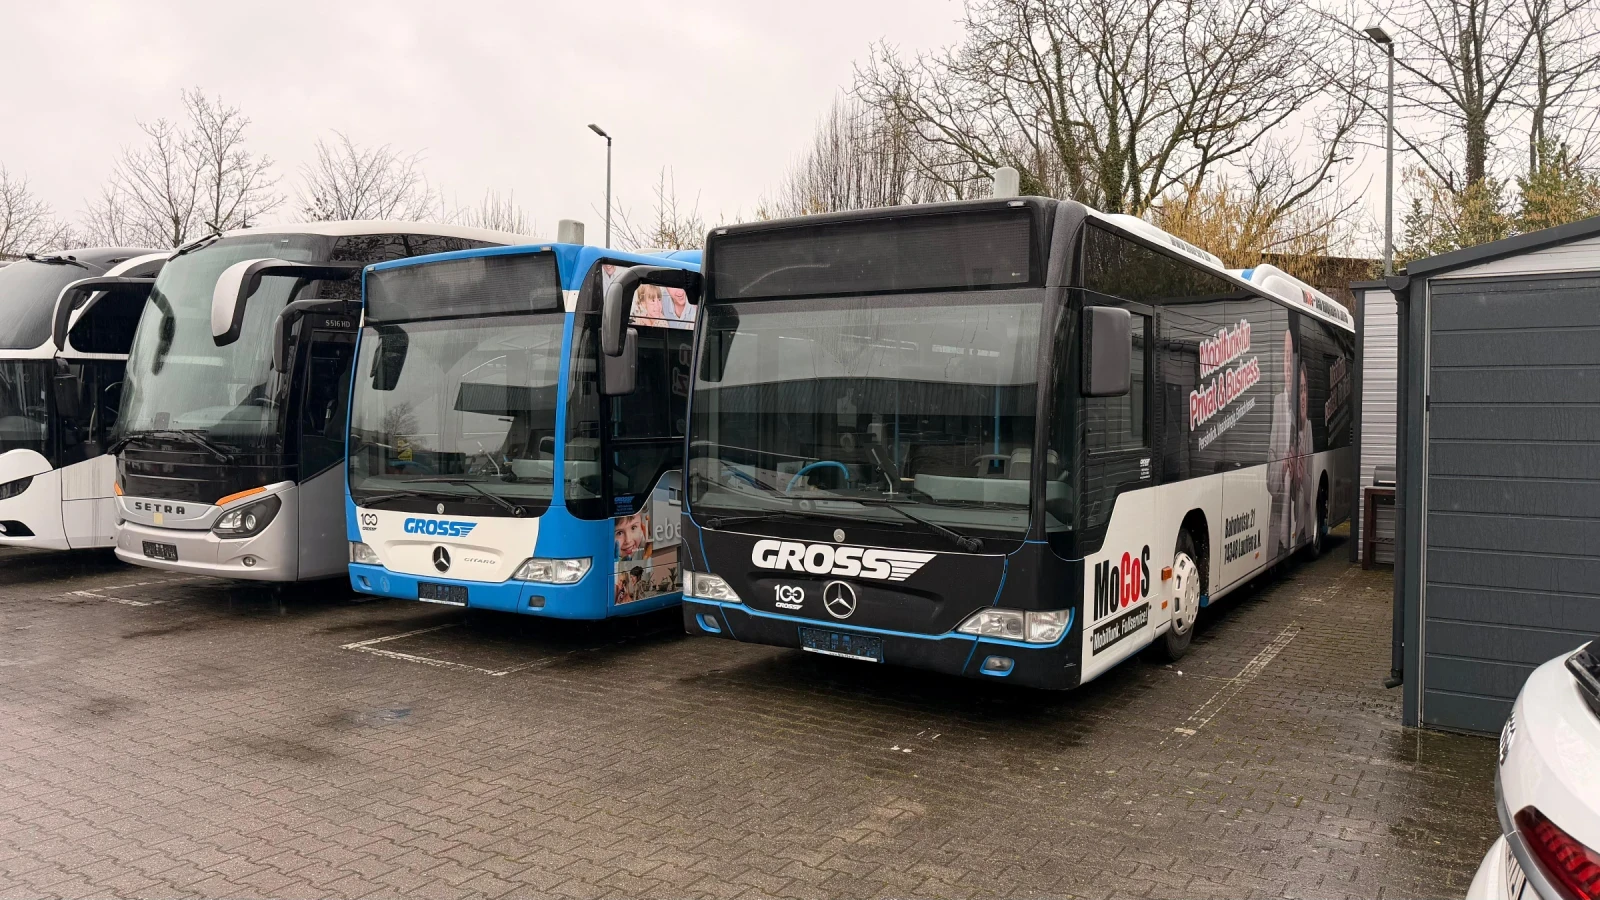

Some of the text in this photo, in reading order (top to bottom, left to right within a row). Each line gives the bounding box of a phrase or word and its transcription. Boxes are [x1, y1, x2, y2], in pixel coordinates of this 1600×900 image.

[330, 320, 340, 328] 516
[341, 320, 350, 328] HD
[1199, 326, 1240, 379] Mobilfunk
[1190, 377, 1217, 432] Privat
[1218, 372, 1226, 411] &
[135, 501, 186, 515] SETRA
[361, 513, 378, 526] 100
[404, 517, 477, 538] GROSS
[1250, 508, 1256, 528] 21
[464, 557, 496, 565] CITARO
[752, 539, 937, 582] GROSS
[1094, 544, 1150, 622] MoCoS
[774, 584, 805, 603] 100
[775, 602, 803, 610] GROSS
